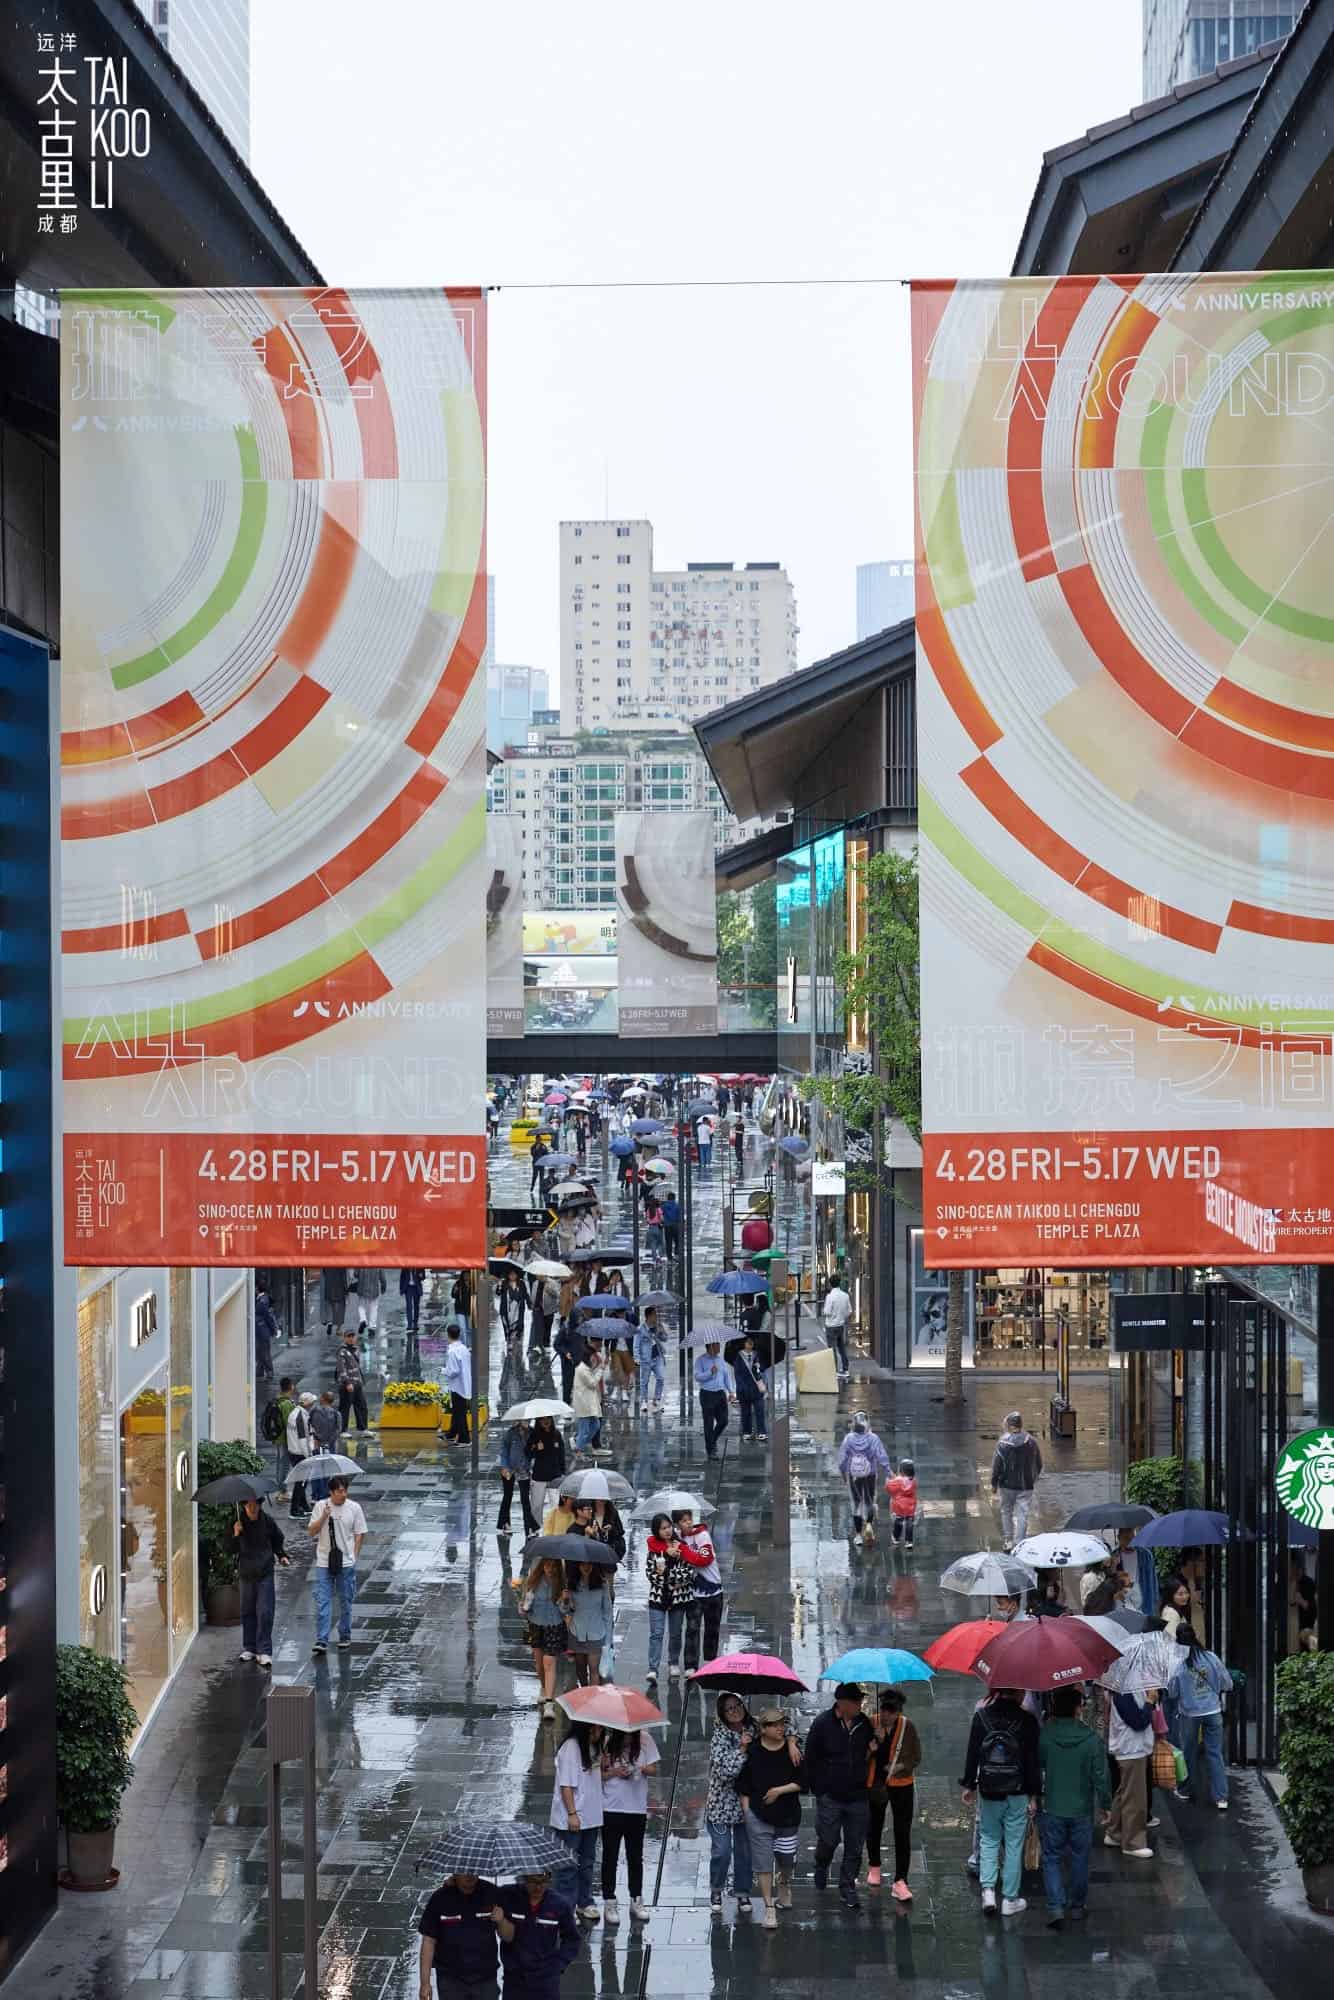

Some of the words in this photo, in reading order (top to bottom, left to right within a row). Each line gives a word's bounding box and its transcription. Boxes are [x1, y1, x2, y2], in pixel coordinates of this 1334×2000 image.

[1194, 291, 1334, 312] ANNIVERSARY
[924, 297, 1058, 363] ALL
[993, 351, 1334, 421] AROUND
[337, 1001, 472, 1018] ANNIVERSARY
[74, 1000, 205, 1059] ALL
[143, 1055, 475, 1119] AROUND
[96, 1160, 115, 1181] TAI
[75, 1160, 94, 1227] 太古里
[98, 1183, 125, 1204] KOO
[98, 1205, 109, 1227] LI
[199, 1204, 272, 1219] SINO-OCEAN
[276, 1205, 319, 1219] TAIKOO
[323, 1206, 335, 1219] LI
[339, 1206, 397, 1219] CHENGDU
[936, 1205, 1012, 1220] SINO-OCEAN
[1016, 1205, 1060, 1219] TAIKOO
[1065, 1204, 1077, 1218] LI
[1081, 1203, 1140, 1218] CHENGDU
[296, 1225, 347, 1240] TEMPLE
[353, 1225, 397, 1240] PLAZA
[1036, 1224, 1088, 1239] TEMPLE
[1096, 1223, 1140, 1238] PLAZA
